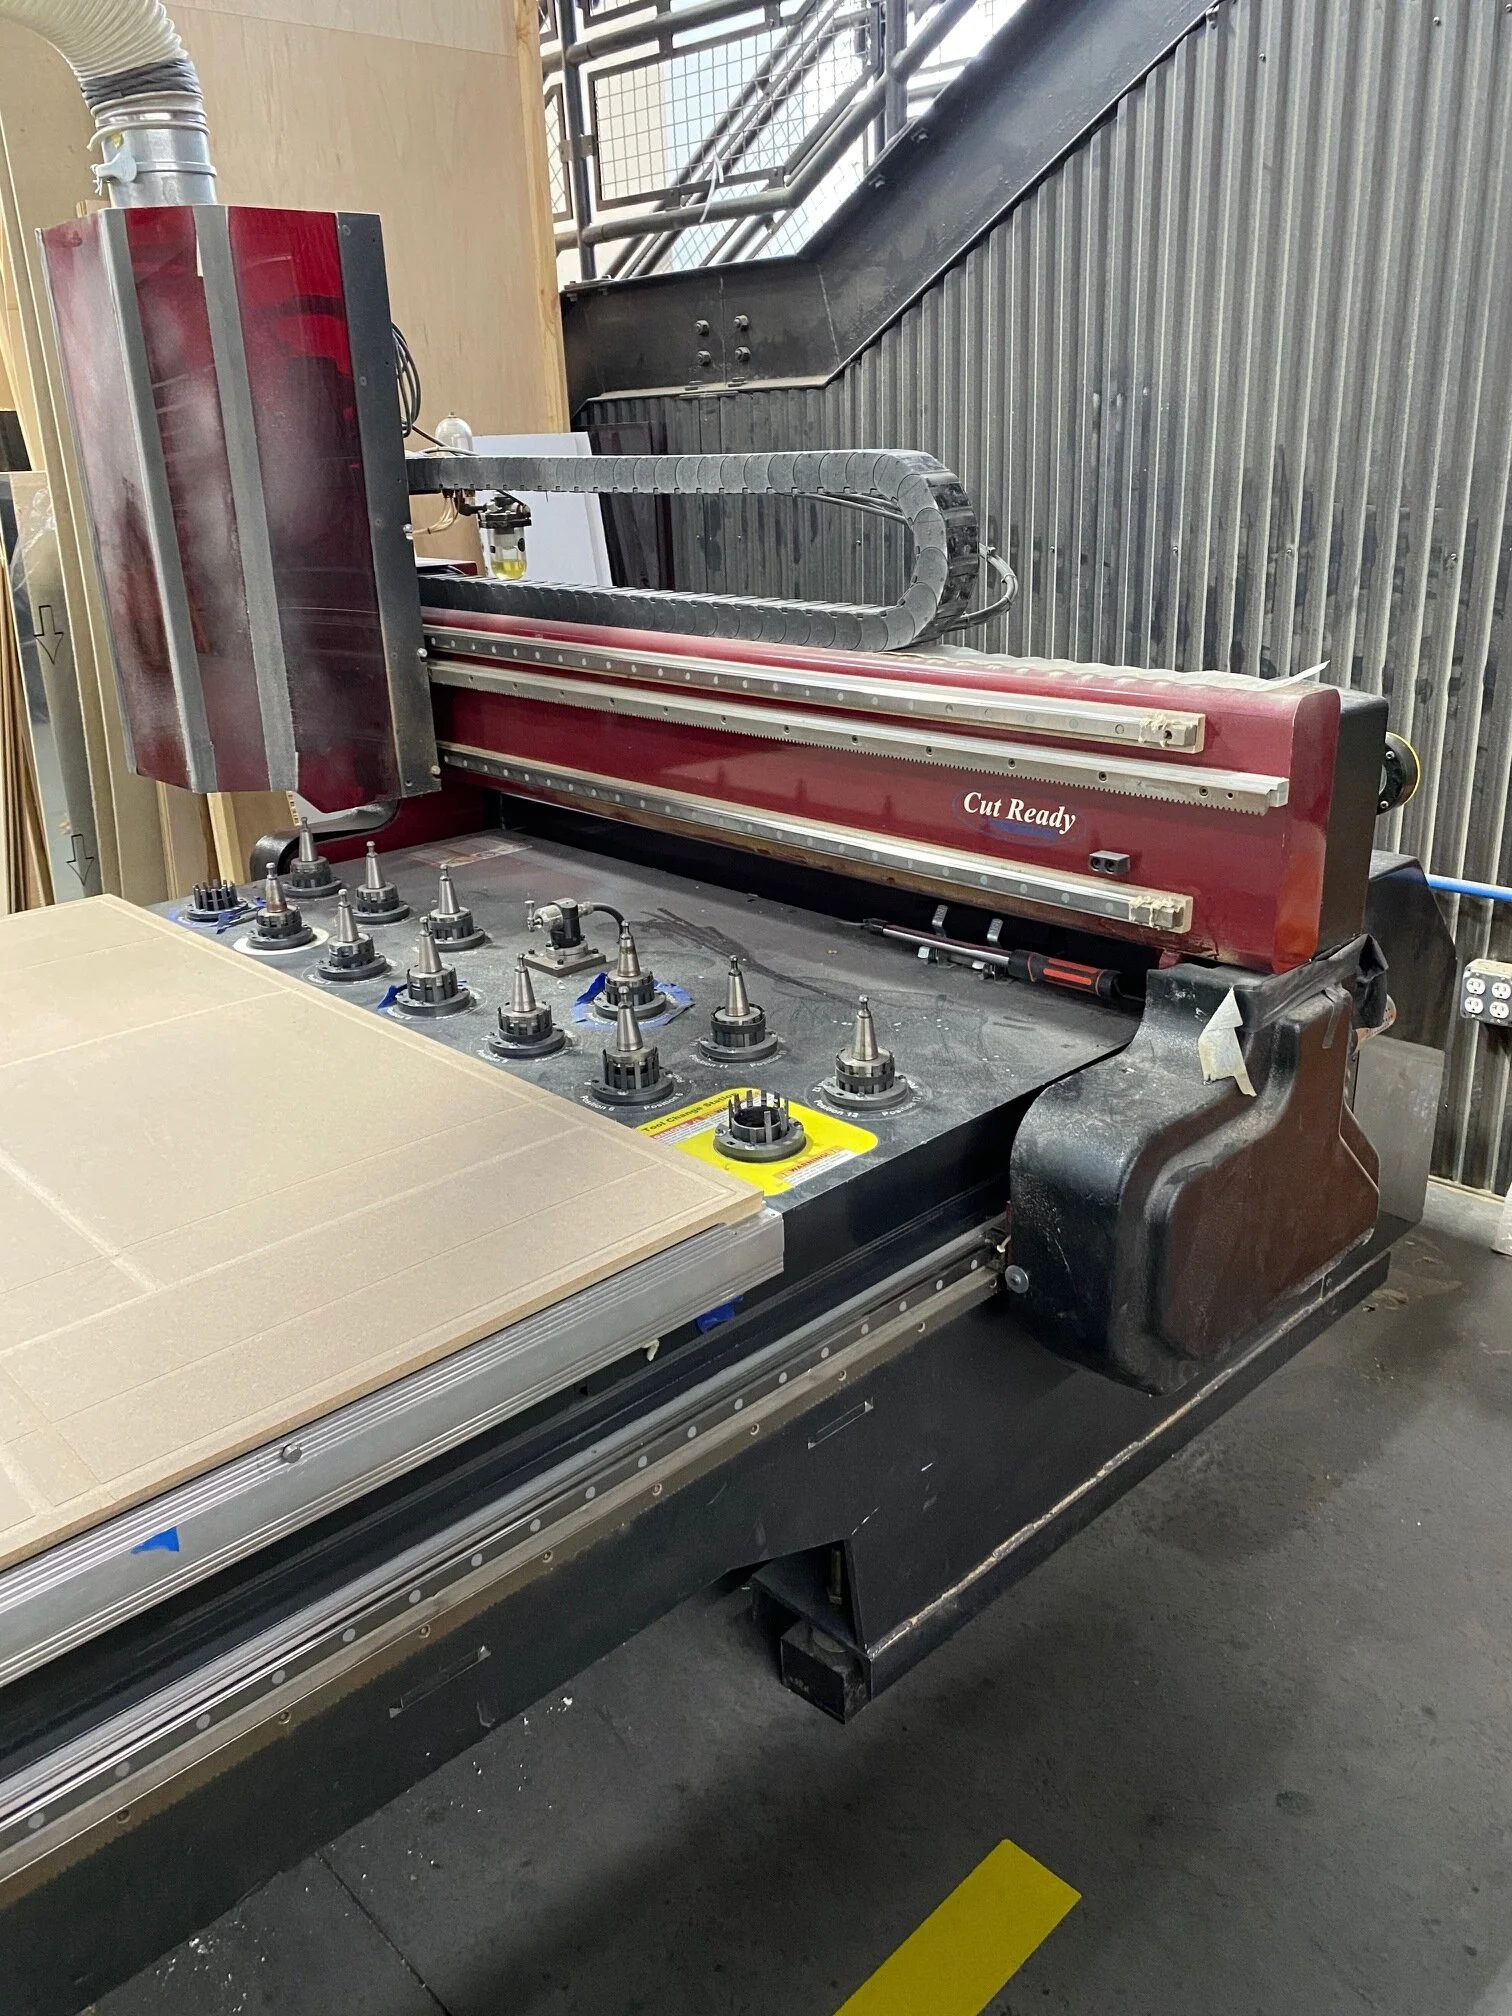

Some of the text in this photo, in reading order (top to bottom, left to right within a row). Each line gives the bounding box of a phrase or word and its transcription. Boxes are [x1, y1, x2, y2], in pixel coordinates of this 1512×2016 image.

[963, 791, 1077, 835] Cut Ready
[580, 1095, 607, 1110] Position
[643, 1096, 680, 1110] Position
[813, 1099, 844, 1116] Position
[881, 1102, 917, 1117] Position
[641, 1121, 666, 1132] Tool
[666, 1106, 704, 1123] Change
